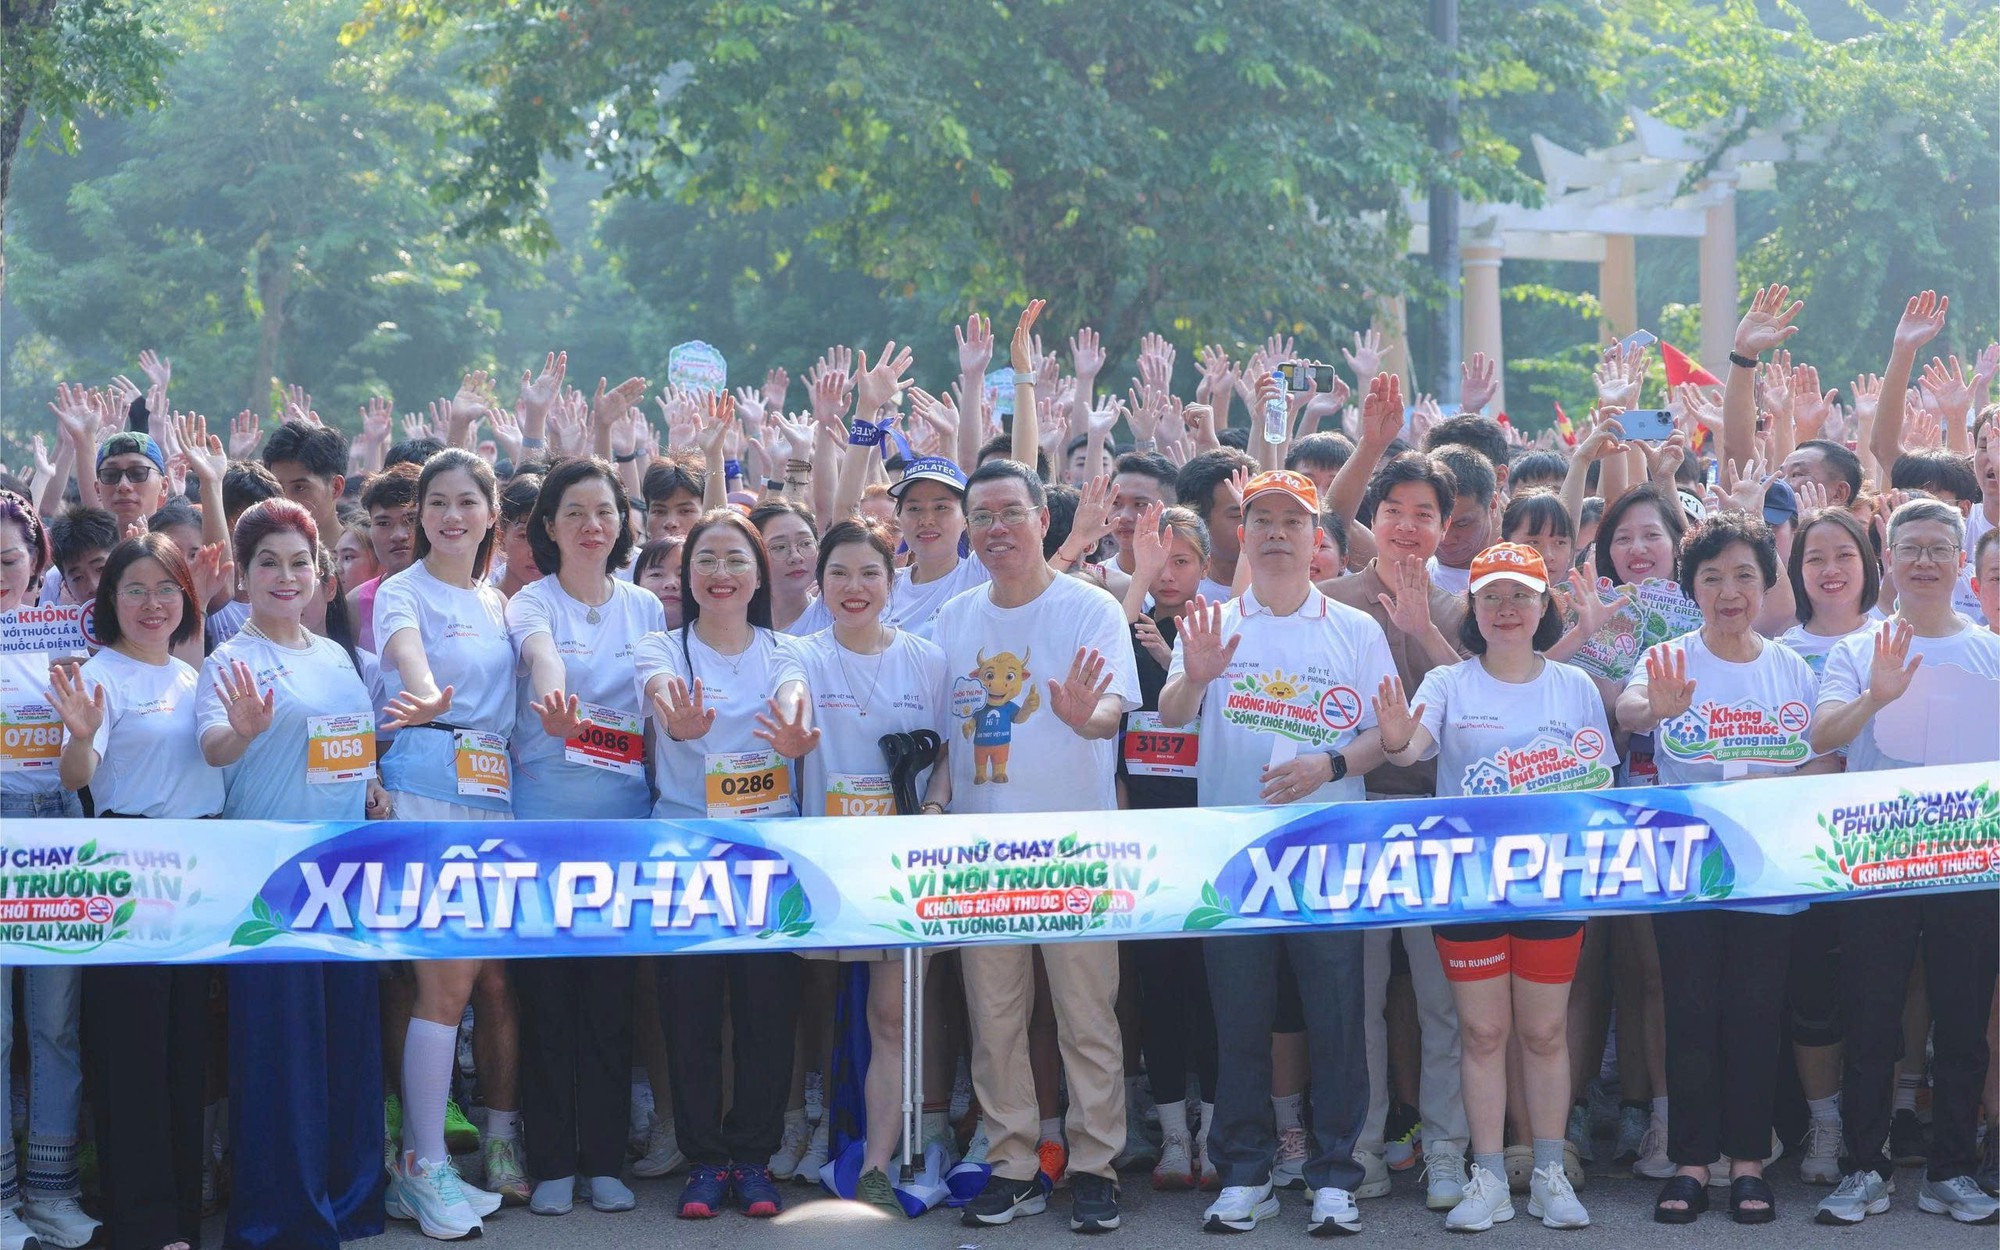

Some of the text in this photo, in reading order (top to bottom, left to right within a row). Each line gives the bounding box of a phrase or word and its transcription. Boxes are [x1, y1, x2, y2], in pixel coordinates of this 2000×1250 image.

[906, 463, 956, 477] MEDLATEC
[1487, 550, 1526, 566] TYM
[1640, 591, 1678, 606] BREATHE
[1680, 599, 1701, 610] CLEA
[1650, 601, 1703, 618] LIVE GREEN
[0, 604, 79, 624] NÓI KHÔNG
[3, 622, 78, 637] VỚI THUỐC LÁ &
[33, 638, 45, 650] LÁ
[47, 638, 70, 650] ĐIỆN
[1228, 692, 1318, 722] KHÔNG HÚT THUỐC
[1710, 706, 1762, 728] Không
[1232, 710, 1260, 724] SỐNG
[1302, 724, 1329, 740] NGÀY
[1708, 720, 1779, 740] hút thuốc
[4, 727, 60, 747] 0788
[579, 728, 629, 752] 0086
[1136, 736, 1185, 754] 3137
[1722, 734, 1787, 746] trong nhà
[321, 738, 363, 760] 1058
[1506, 748, 1558, 772] Không
[468, 754, 506, 776] 1024
[1509, 755, 1578, 788] hút thuốc
[721, 772, 774, 796] 0286
[1526, 772, 1561, 790] trong
[1562, 764, 1588, 780] nhà
[840, 798, 893, 816] 1027
[1843, 800, 1980, 836] PHỤ NỮ CHẠY
[1842, 835, 1870, 867] VÌ
[1923, 818, 1998, 857] TRƯỜN
[12, 846, 74, 870] CHẠY
[908, 840, 1054, 869] PHỤ NỮ CHẠY
[1240, 810, 1711, 914] XUẤT PHÁT
[1858, 862, 1905, 884] KHÔNG
[1908, 859, 1939, 878] KHÓI
[1942, 850, 1985, 872] THUỐC
[13, 866, 132, 899] TRƯỜNG
[291, 838, 788, 929] XUẤT PHÁT
[908, 858, 1109, 899] VÌ MÔI TRƯỜNG
[31, 899, 80, 918] THUỐC
[923, 893, 1060, 917] KHÔNG KHÓI THUỐC
[26, 924, 53, 942] LAI
[56, 923, 104, 942] XANH
[920, 915, 1083, 936] VÀ TƯƠNG LAI XANH
[1449, 952, 1506, 968] BUBI RUNNING
